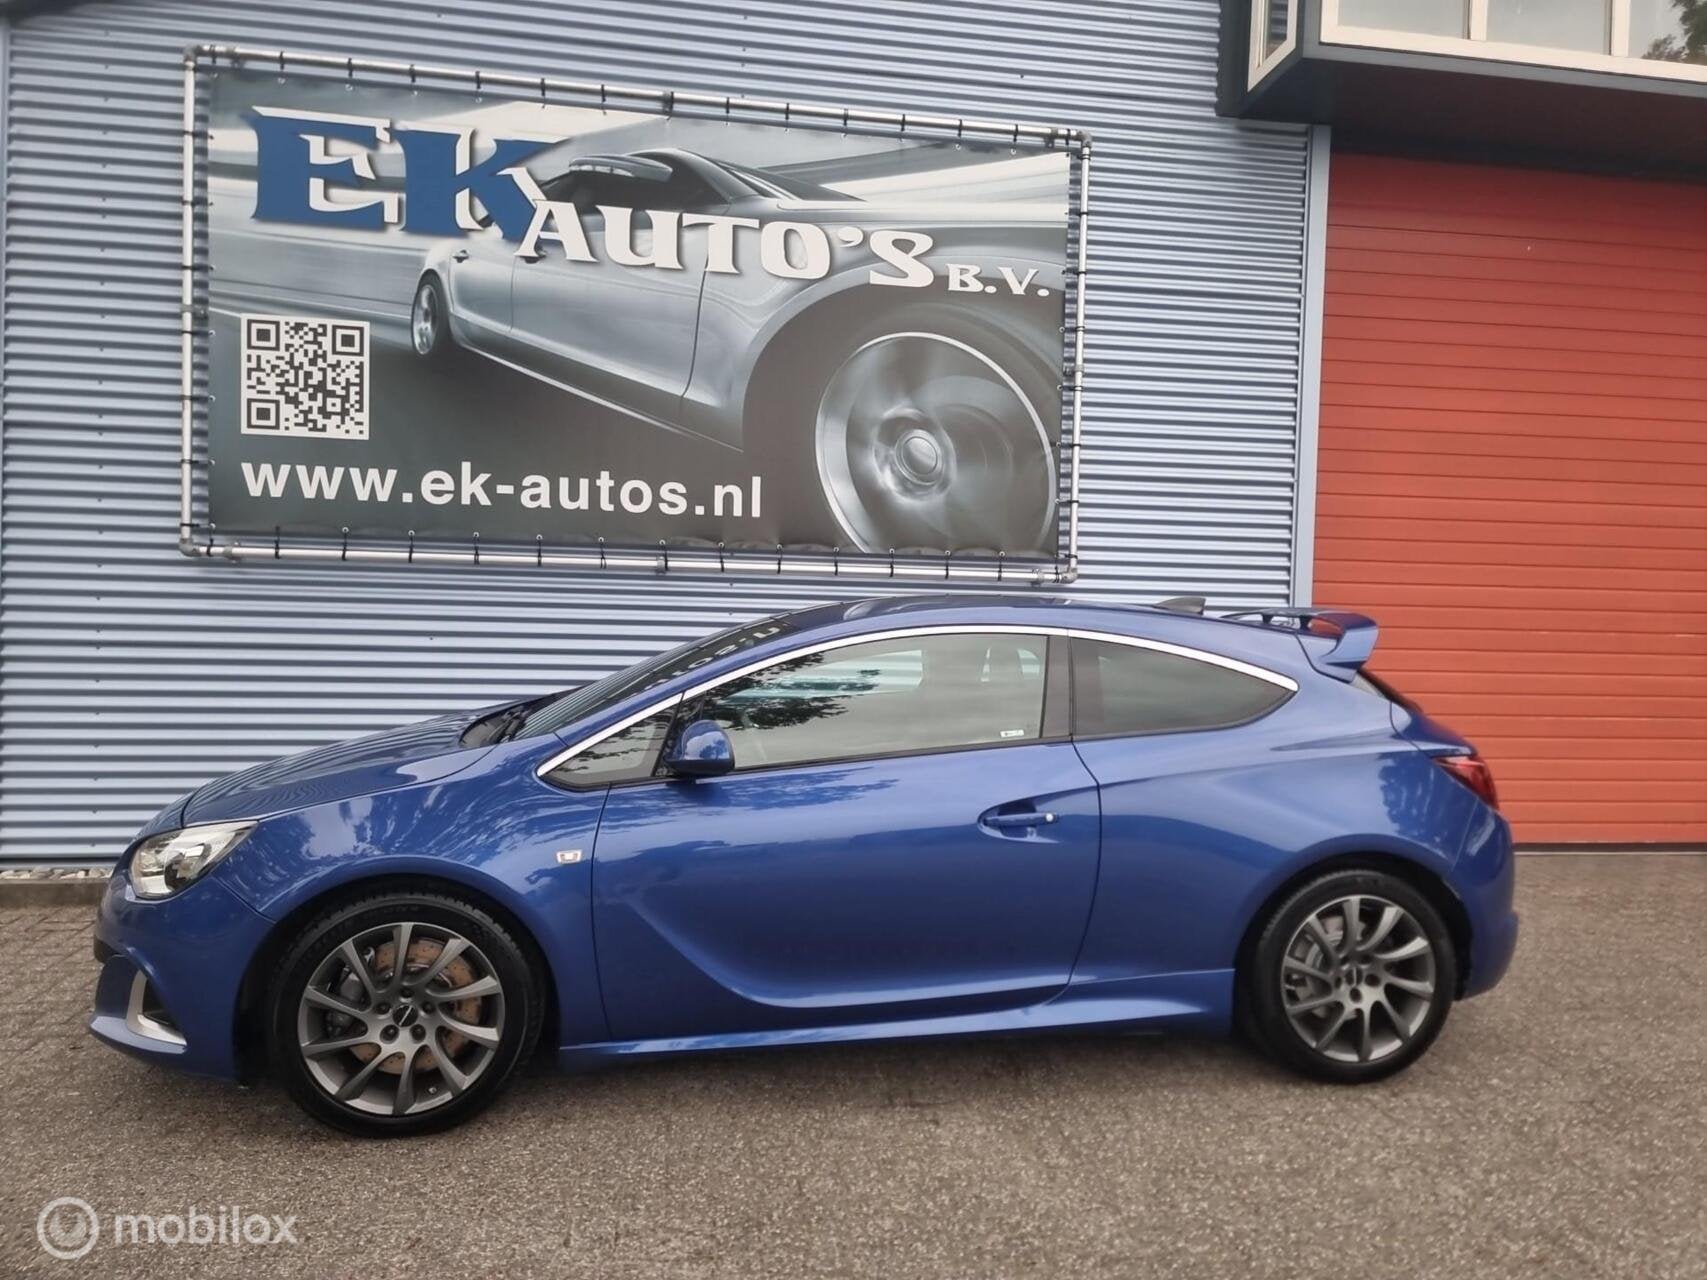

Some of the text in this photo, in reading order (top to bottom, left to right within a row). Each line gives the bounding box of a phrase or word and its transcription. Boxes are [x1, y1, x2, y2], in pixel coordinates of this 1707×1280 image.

[242, 106, 571, 241] EK
[946, 263, 1049, 297] B.V.
[241, 461, 762, 518] www.ek-autos.nl
